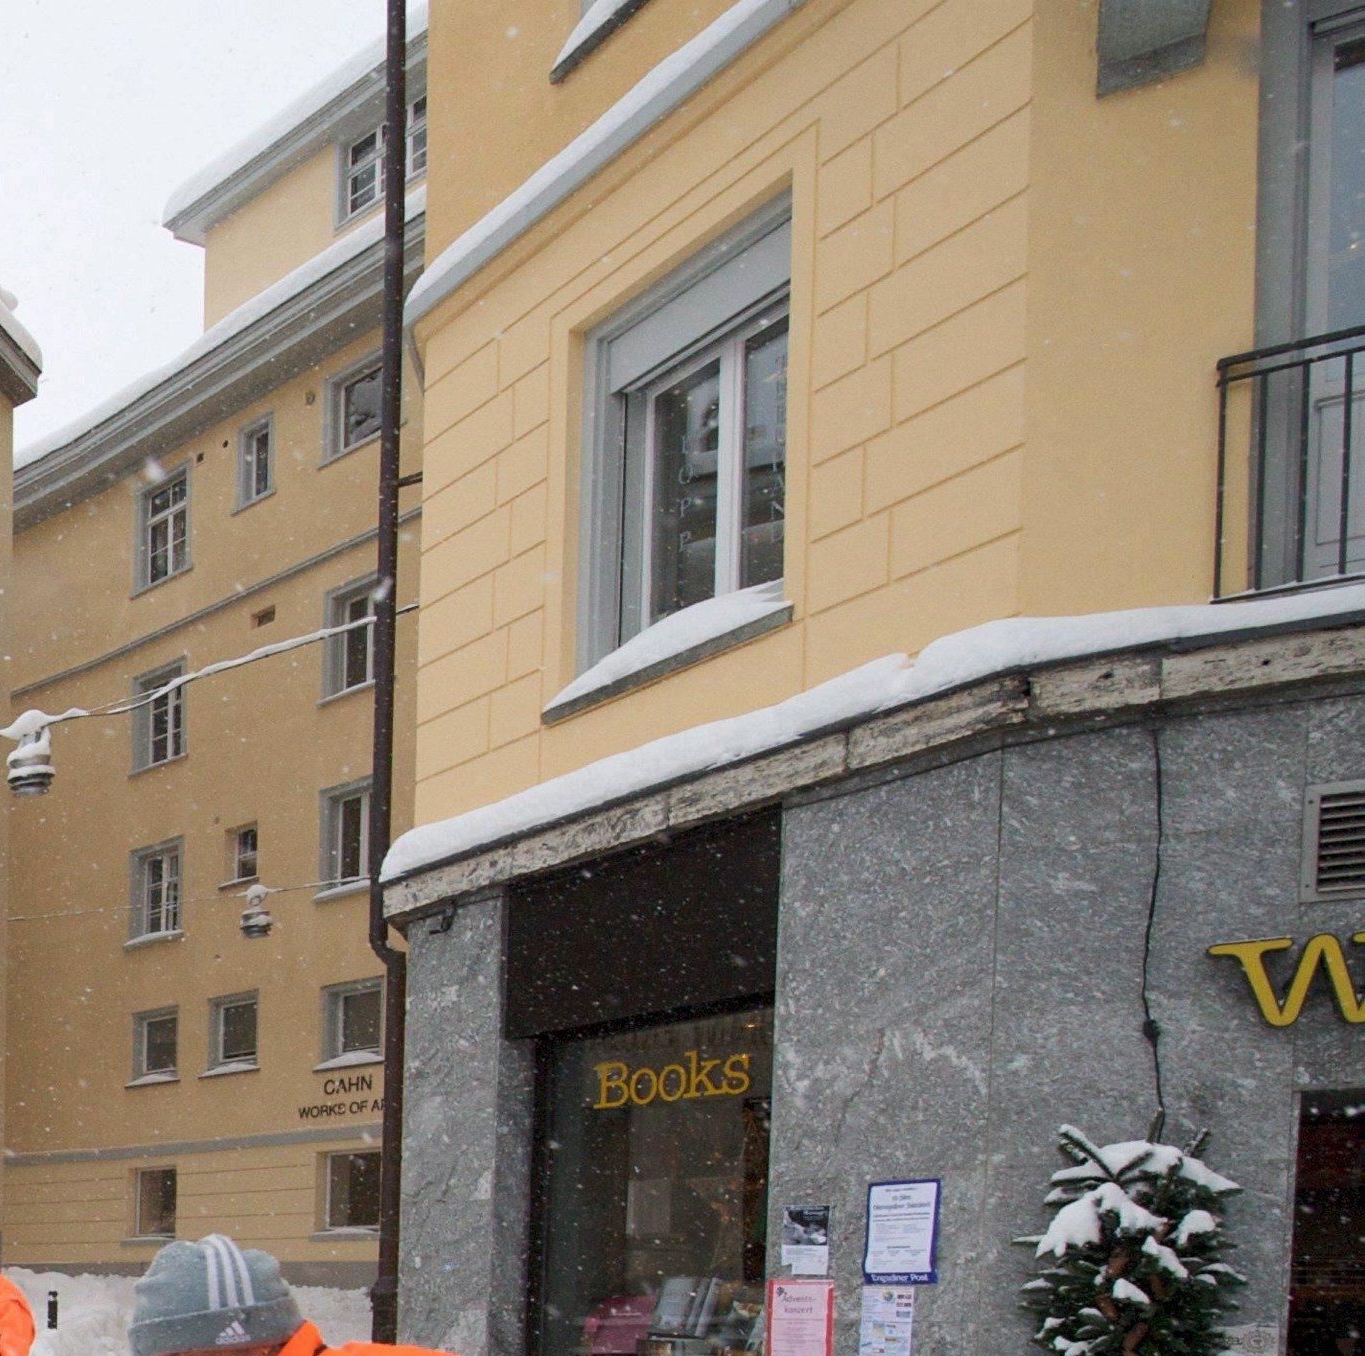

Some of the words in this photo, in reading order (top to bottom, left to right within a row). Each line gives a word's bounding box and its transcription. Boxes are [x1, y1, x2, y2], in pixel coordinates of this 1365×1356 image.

[323, 1074, 373, 1095] CAHN
[592, 1050, 752, 1110] Books
[298, 1103, 346, 1119] WORKS
[349, 1100, 368, 1114] OF
